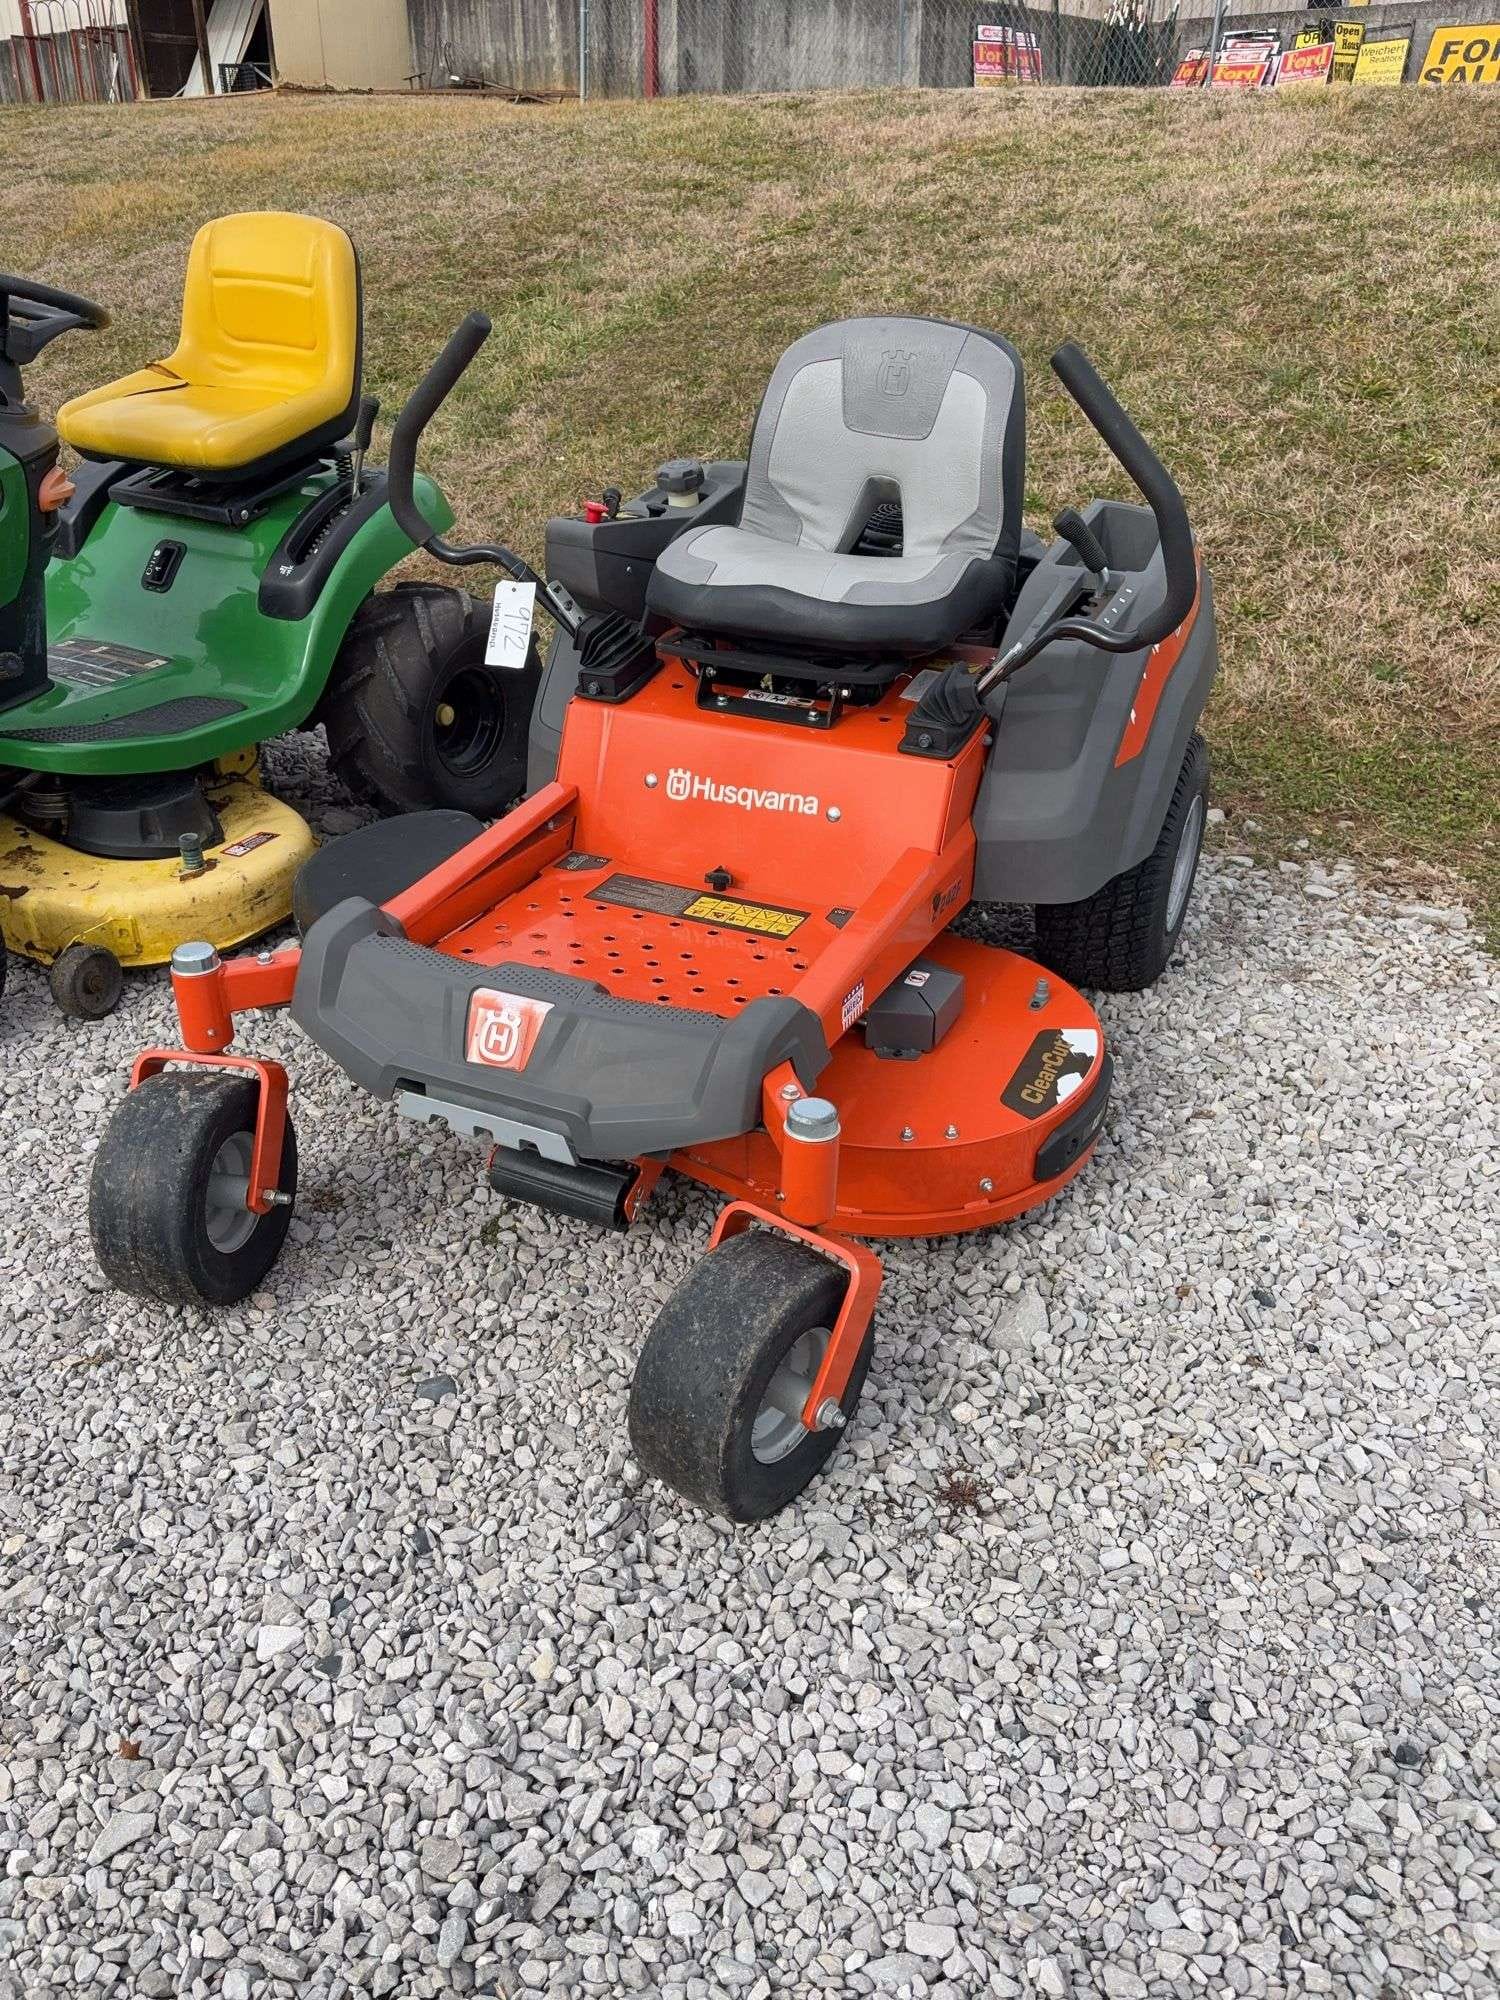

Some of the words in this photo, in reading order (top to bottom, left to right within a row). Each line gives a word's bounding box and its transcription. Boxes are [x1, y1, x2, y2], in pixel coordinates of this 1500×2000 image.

[1336, 25, 1360, 37] Open
[1342, 39, 1360, 50] Hous
[1361, 45, 1405, 57] Weichert
[1286, 46, 1329, 73] Ford
[1214, 64, 1262, 80] Ford
[504, 606, 531, 651] 972
[692, 775, 819, 815] Husqvarna
[1020, 1038, 1073, 1105] ClearCut
